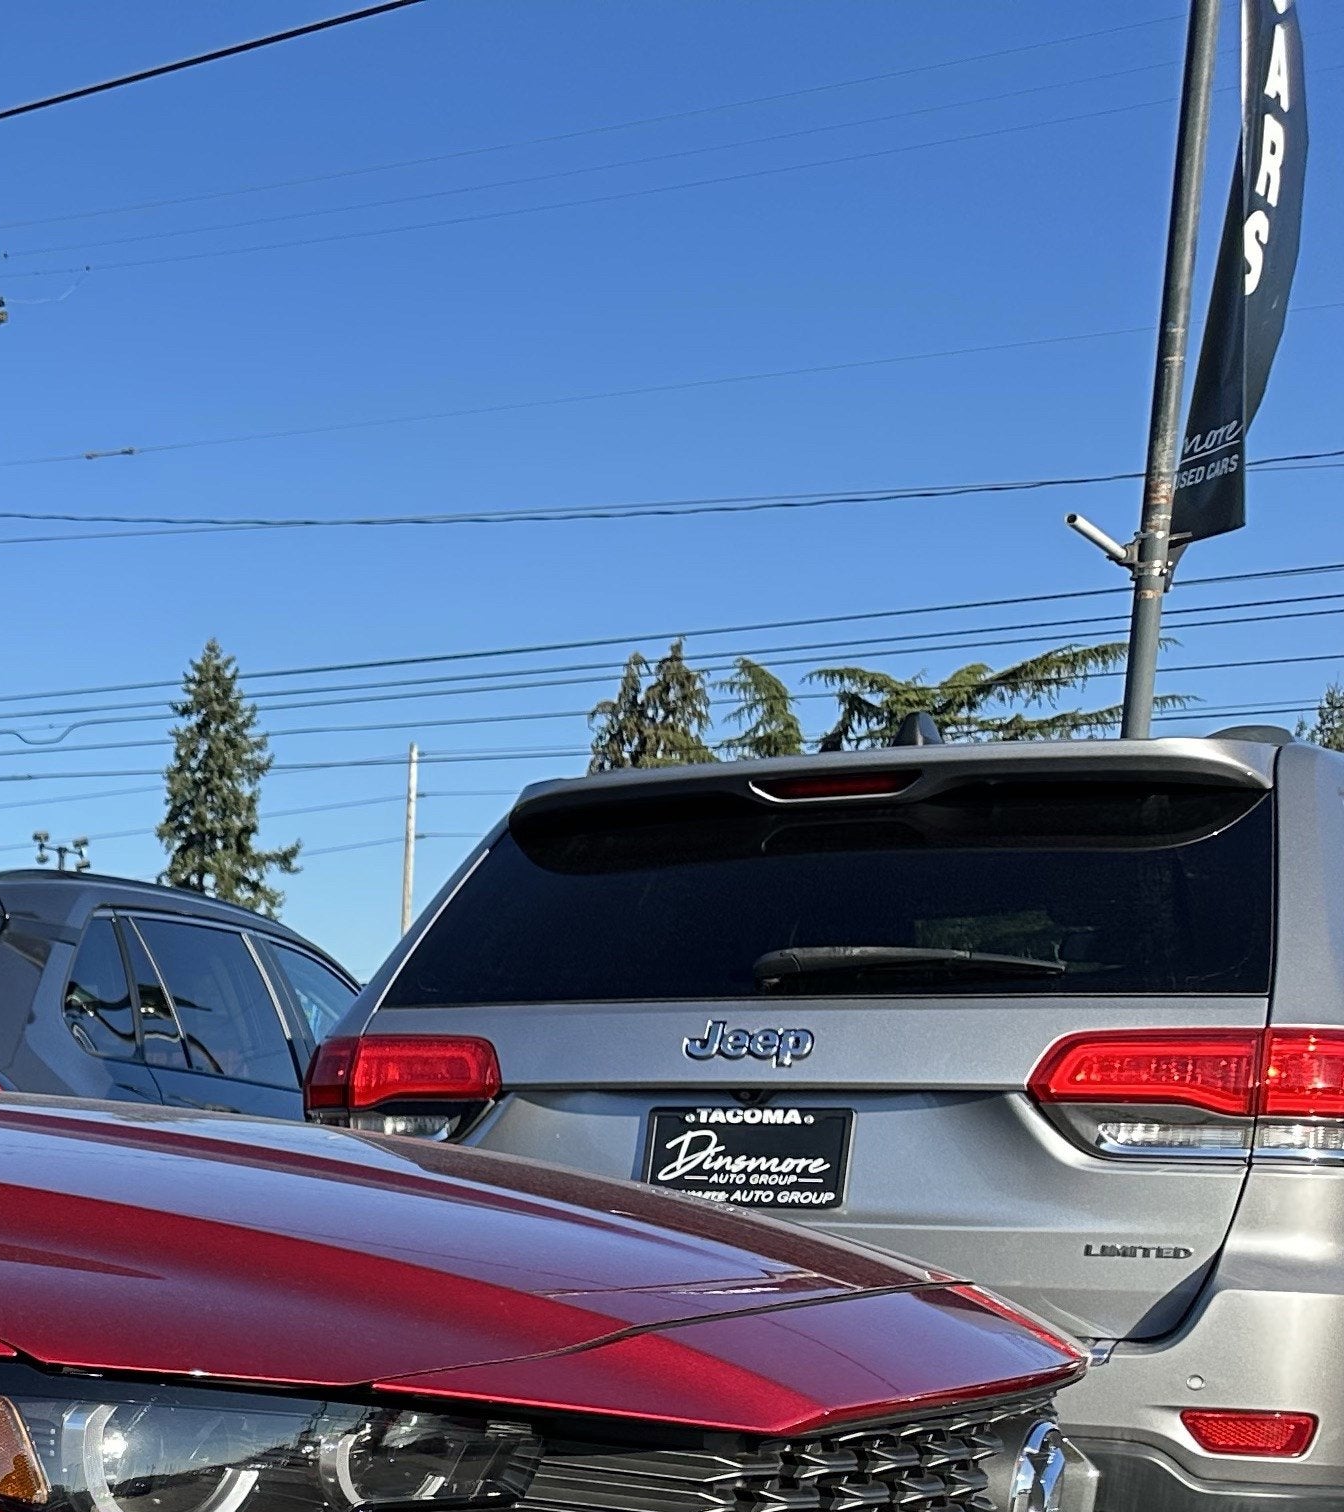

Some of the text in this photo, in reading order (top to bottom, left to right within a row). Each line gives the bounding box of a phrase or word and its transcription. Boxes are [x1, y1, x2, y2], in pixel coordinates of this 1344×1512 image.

[1243, 0, 1290, 295] ARS
[1206, 454, 1239, 480] CARS
[682, 1019, 815, 1069] Jeep
[696, 1108, 802, 1125] TACOMA
[657, 1129, 831, 1182] Dinsmore
[708, 1173, 798, 1186] AUTO GROUP
[729, 1190, 773, 1204] AUTO
[776, 1191, 836, 1205] GROUP
[1083, 1243, 1194, 1260] LIMITED
